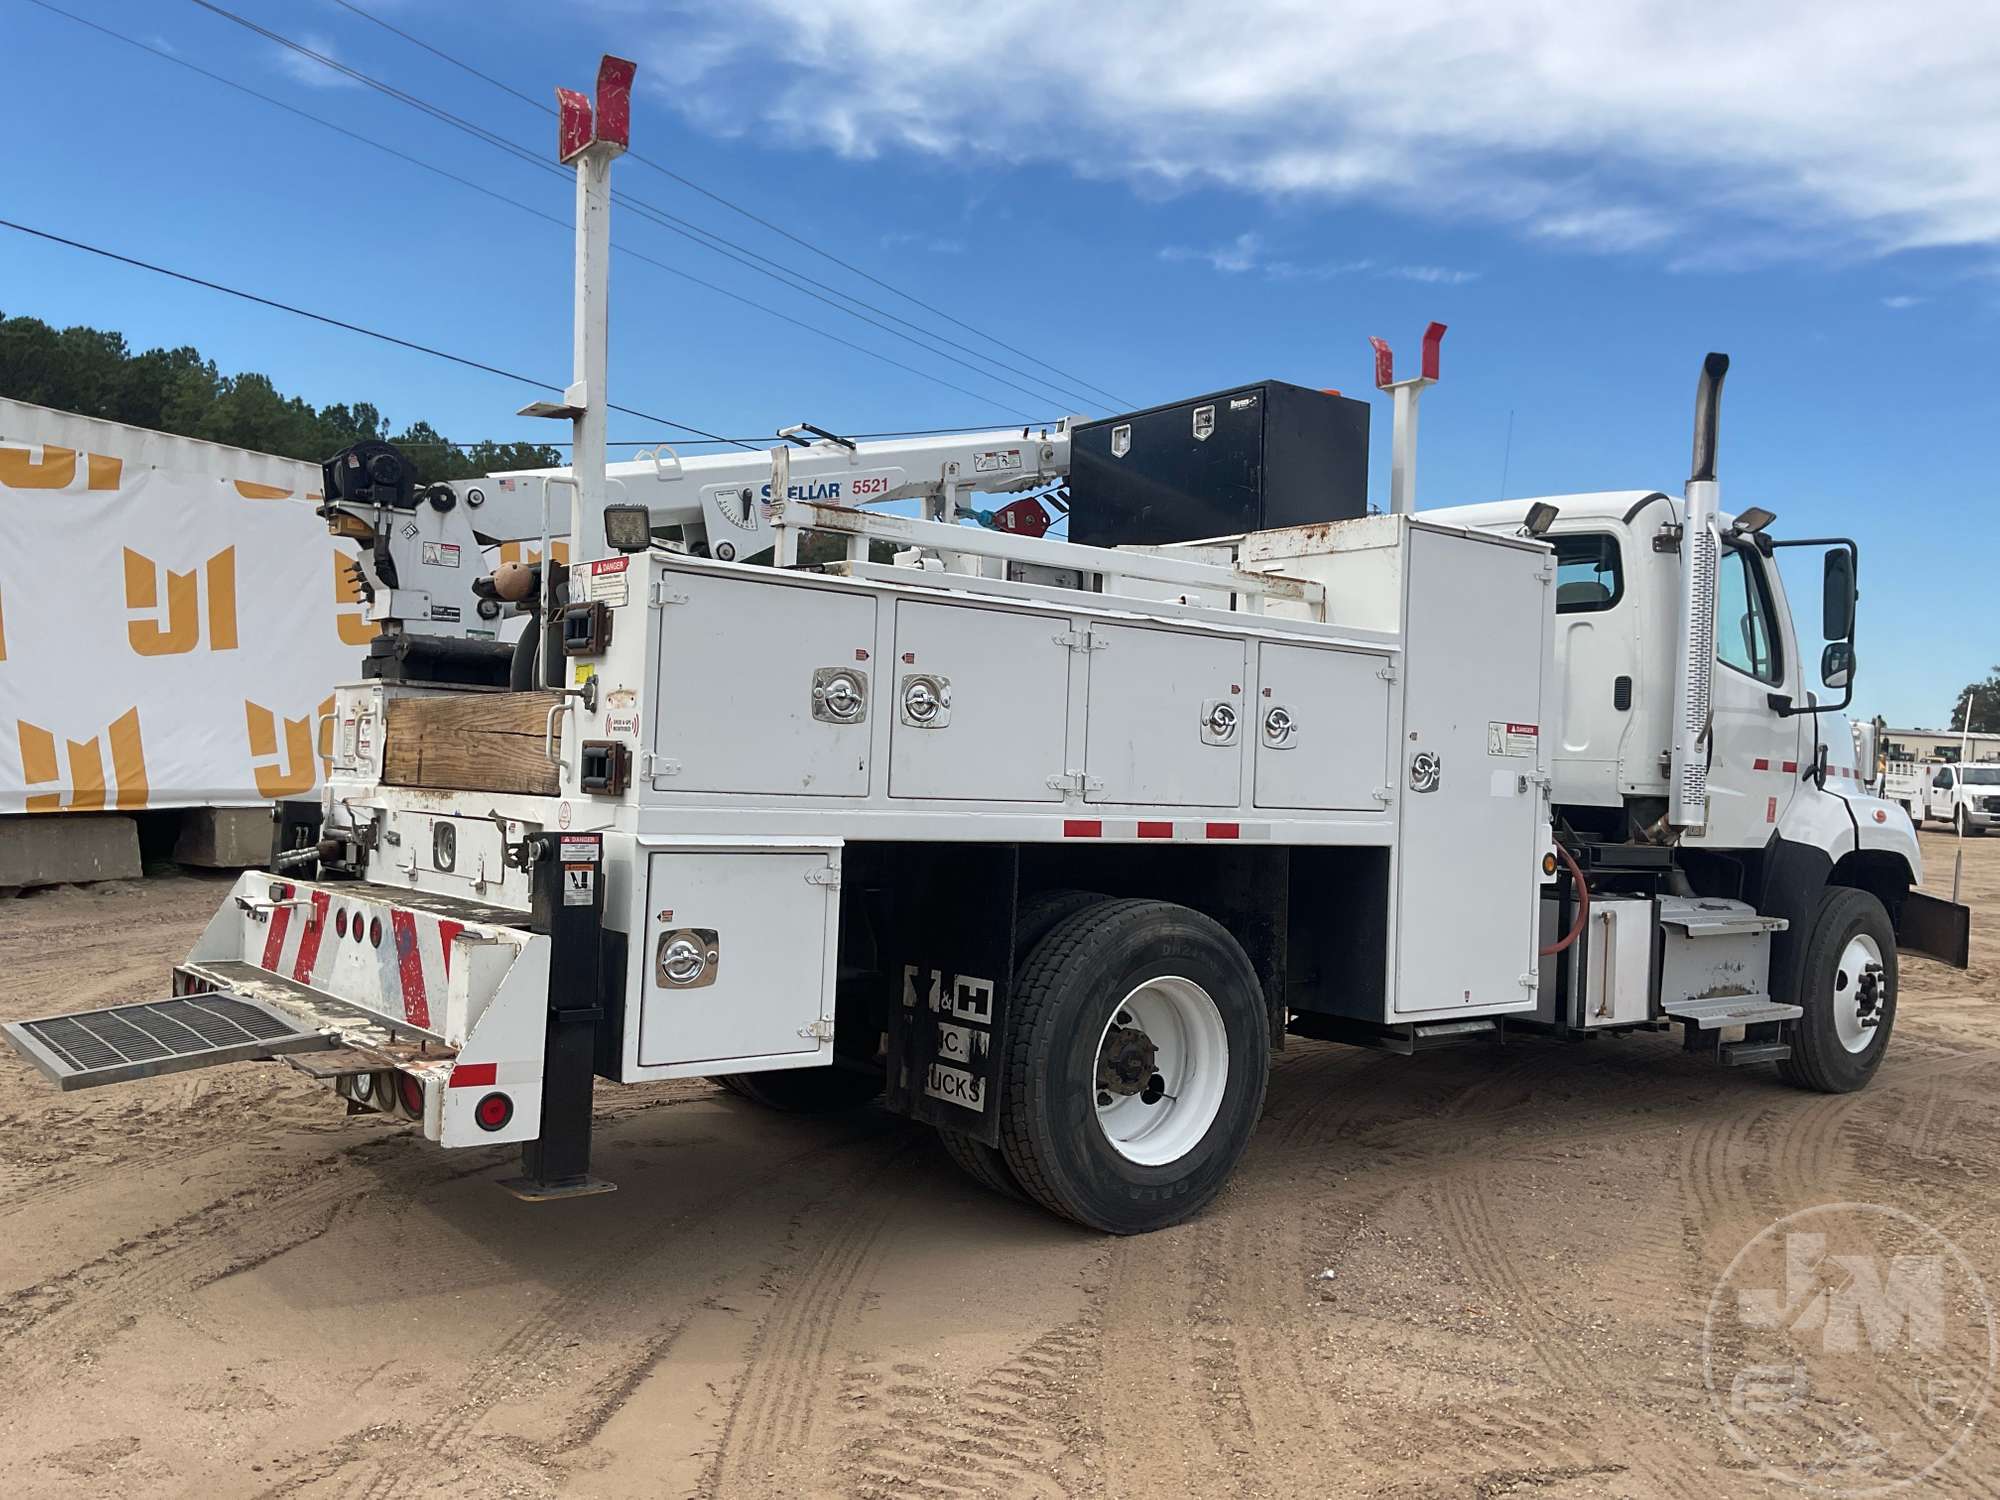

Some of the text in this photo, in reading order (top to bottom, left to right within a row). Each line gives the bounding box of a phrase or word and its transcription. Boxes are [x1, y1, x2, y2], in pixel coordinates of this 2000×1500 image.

[852, 477, 889, 495] 5521
[602, 560, 624, 572] DANGER
[957, 984, 989, 1016] H
